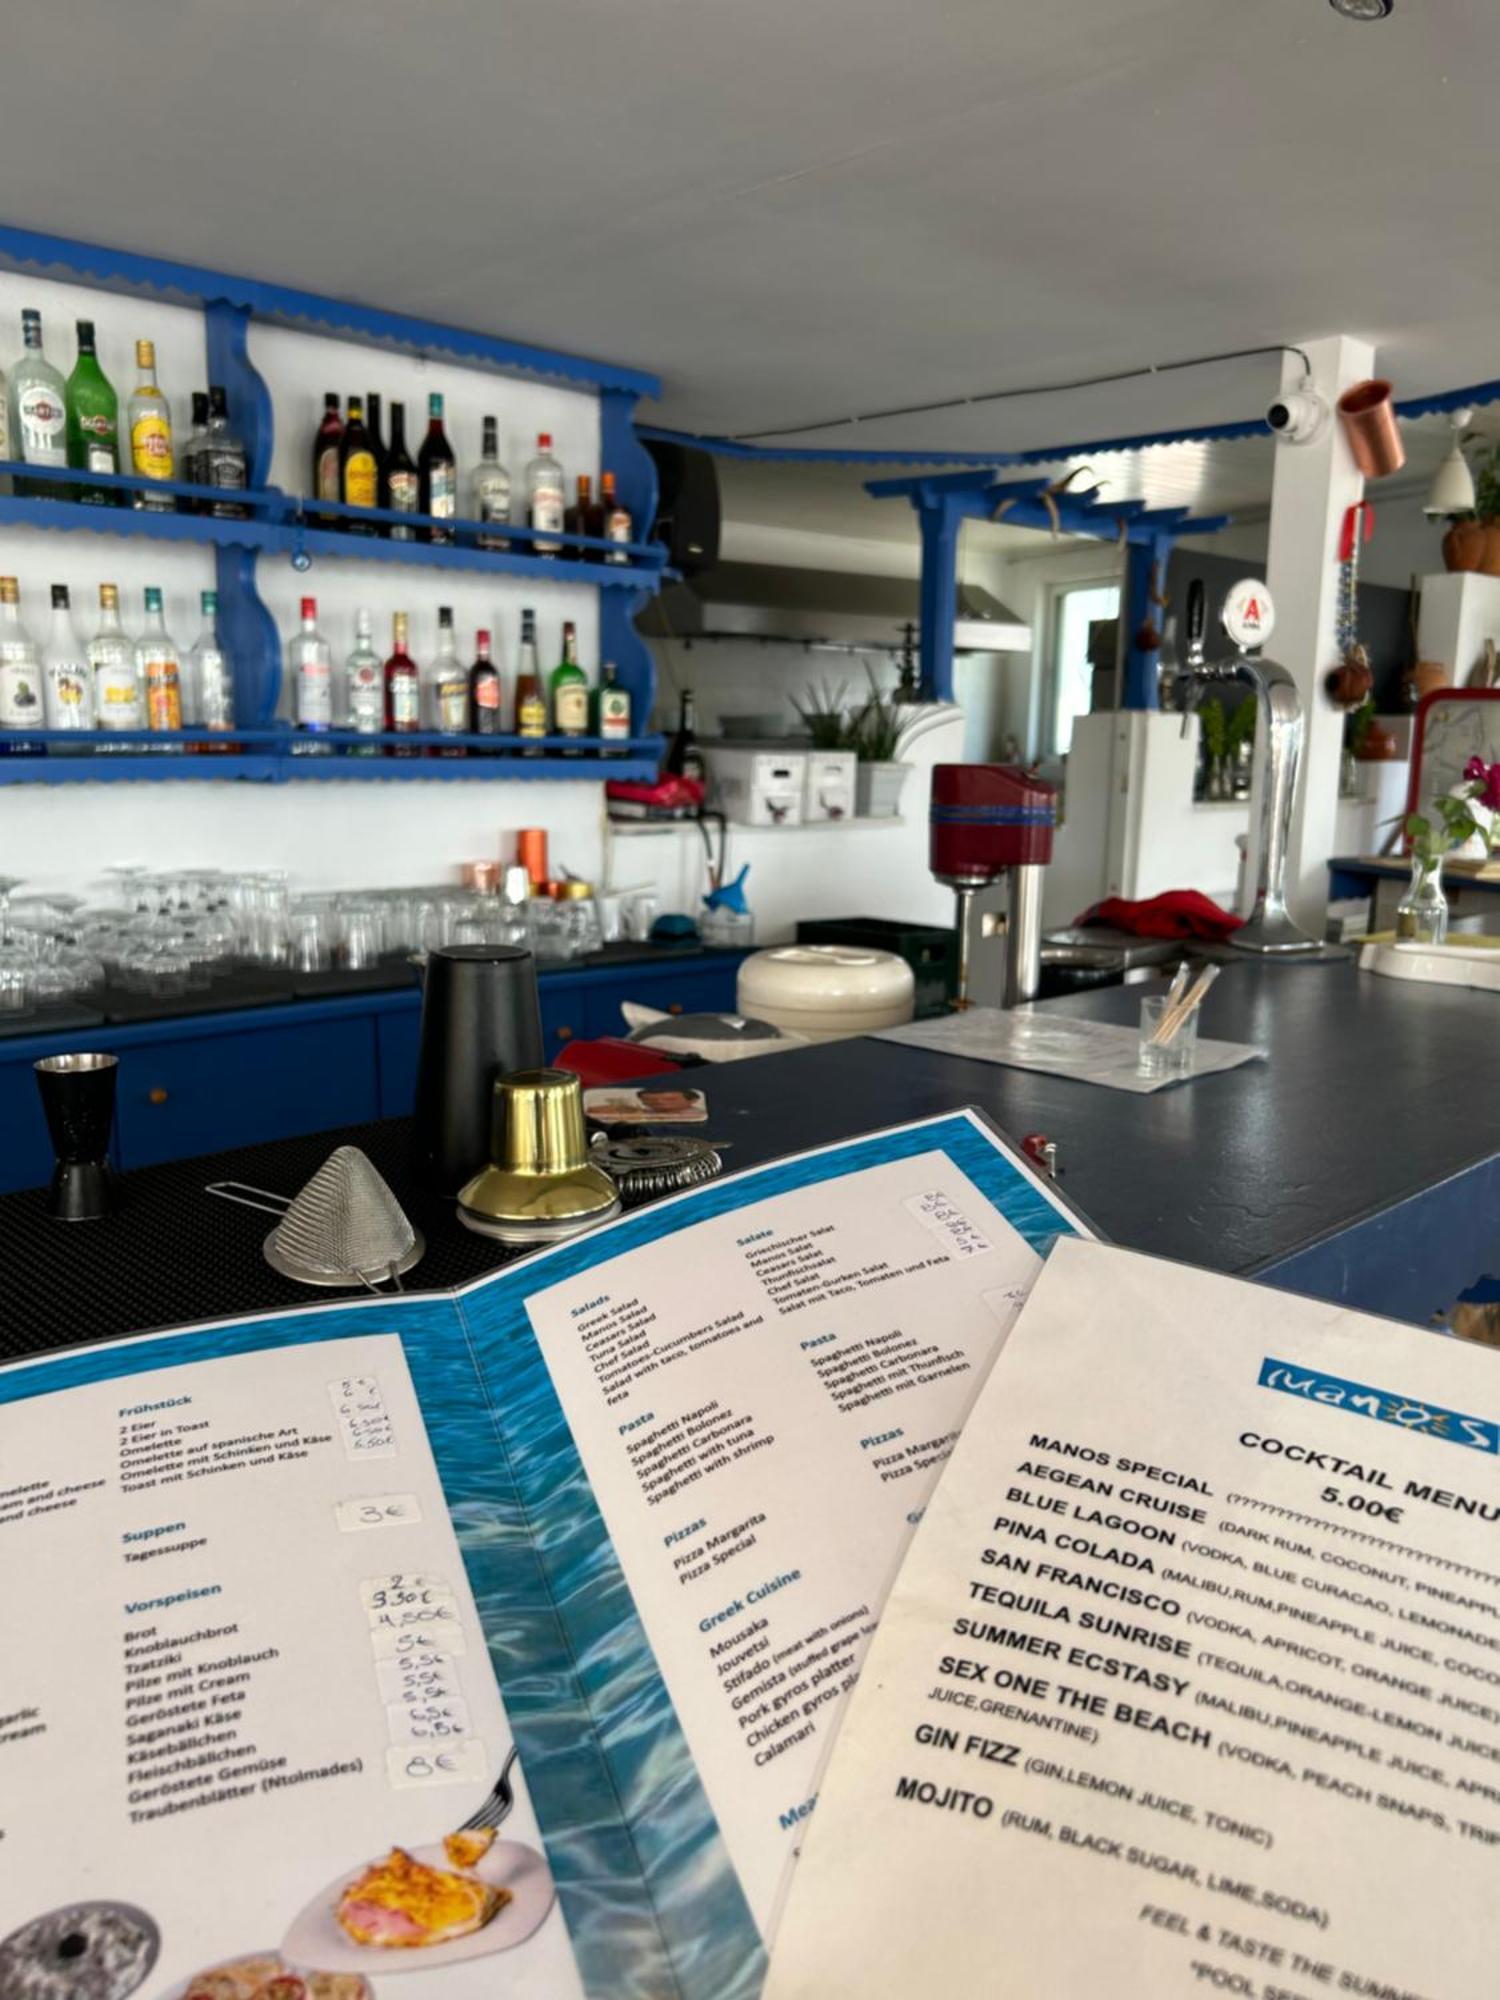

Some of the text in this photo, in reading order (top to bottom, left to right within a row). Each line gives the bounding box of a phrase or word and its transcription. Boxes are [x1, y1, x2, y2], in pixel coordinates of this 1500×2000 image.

[736, 1229, 774, 1247] Salate
[570, 1295, 611, 1318] Salads
[577, 1298, 639, 1332] Greek Salad
[581, 1305, 648, 1343] Manos Salad
[585, 1312, 657, 1353] Ceasars Salad
[589, 1329, 647, 1362] Tuna Salad
[597, 1311, 745, 1384] Tomatoes-Cucumbers Salad
[799, 1333, 837, 1351] Pasta
[810, 1330, 903, 1368] Spaghetti Napoli
[593, 1339, 651, 1374] Chef Salad
[601, 1373, 633, 1396] Salad
[633, 1362, 659, 1379] with
[688, 1325, 742, 1352] tomatoes
[742, 1314, 764, 1329] and
[816, 1353, 872, 1379] Spaghetti
[118, 1396, 192, 1418] Frühstück
[606, 1390, 630, 1407] feta
[119, 1420, 156, 1435] 2 Eier
[119, 1420, 210, 1447] 2 Eier in Toast
[618, 1412, 655, 1436] Pasta
[626, 1400, 719, 1455] Spaghetti Napoli
[859, 1428, 905, 1450] Pizzas
[119, 1438, 182, 1457] Omelette
[119, 1427, 298, 1470] Omelette auf spanische Art
[119, 1435, 332, 1481] Omelette mit Schinken und Käse
[631, 1431, 686, 1467] Spaghetti
[636, 1415, 753, 1480] Spaghetti Carbonara
[641, 1429, 755, 1493] Spaghetti with tuna
[1029, 1434, 1213, 1497] MANOS SPECIAL
[120, 1450, 309, 1493] Toast mit Schinken und Käse
[646, 1435, 775, 1506] Spaghetti with shrimp
[1239, 1432, 1500, 1522] COCKTAIL MENU
[1016, 1461, 1207, 1524] AEGEAN CRUISE
[1320, 1486, 1404, 1524] 5.00€
[122, 1522, 186, 1544] Suppen
[663, 1518, 707, 1548] Pizzas
[1005, 1487, 1177, 1546] BLUE LAGOON
[1218, 1520, 1270, 1545] (DARK
[124, 1537, 208, 1563] Tagessuppe
[673, 1513, 767, 1570] Pizza Margarita
[679, 1533, 757, 1585] Pizza Special
[993, 1516, 1155, 1575] PINA COLADA
[980, 1548, 1181, 1616] SAN FRANCISCO
[1252, 1561, 1297, 1585] BLUE
[124, 1584, 222, 1615] Vorspeisen
[698, 1569, 801, 1633] Greek Cuisine
[970, 1581, 1191, 1659] TEQUILA SUNRISE
[123, 1626, 157, 1644] Brot
[124, 1623, 239, 1659] Knoblauchbrot
[709, 1618, 769, 1659] Mousaka
[723, 1605, 870, 1694] Stifado (meat with onions)
[124, 1647, 280, 1693] Pilze mit Knoblauch
[125, 1653, 182, 1675] Tzatziki
[717, 1635, 771, 1677] Jouvetsi
[953, 1618, 1190, 1696] SUMMER ECSTASY
[125, 1672, 251, 1710] Pilze mit Cream
[738, 1653, 855, 1729] Pork gyros platter
[938, 1655, 1212, 1749] SEX ONE THE BEACH
[1350, 1663, 1432, 1701] ORANGE
[125, 1690, 246, 1728] Geröstete Feta
[126, 1710, 242, 1747] Saganaki Käse
[746, 1685, 840, 1748] Chicken gyros
[754, 1720, 816, 1767] Calamari
[914, 1723, 1021, 1767] GIN FIZZ
[127, 1756, 287, 1805] Geröstete Gemüse
[895, 1776, 994, 1819] MOJITO
[129, 1783, 256, 1824] Traubenblätter
[1206, 1811, 1273, 1849] TONIC)
